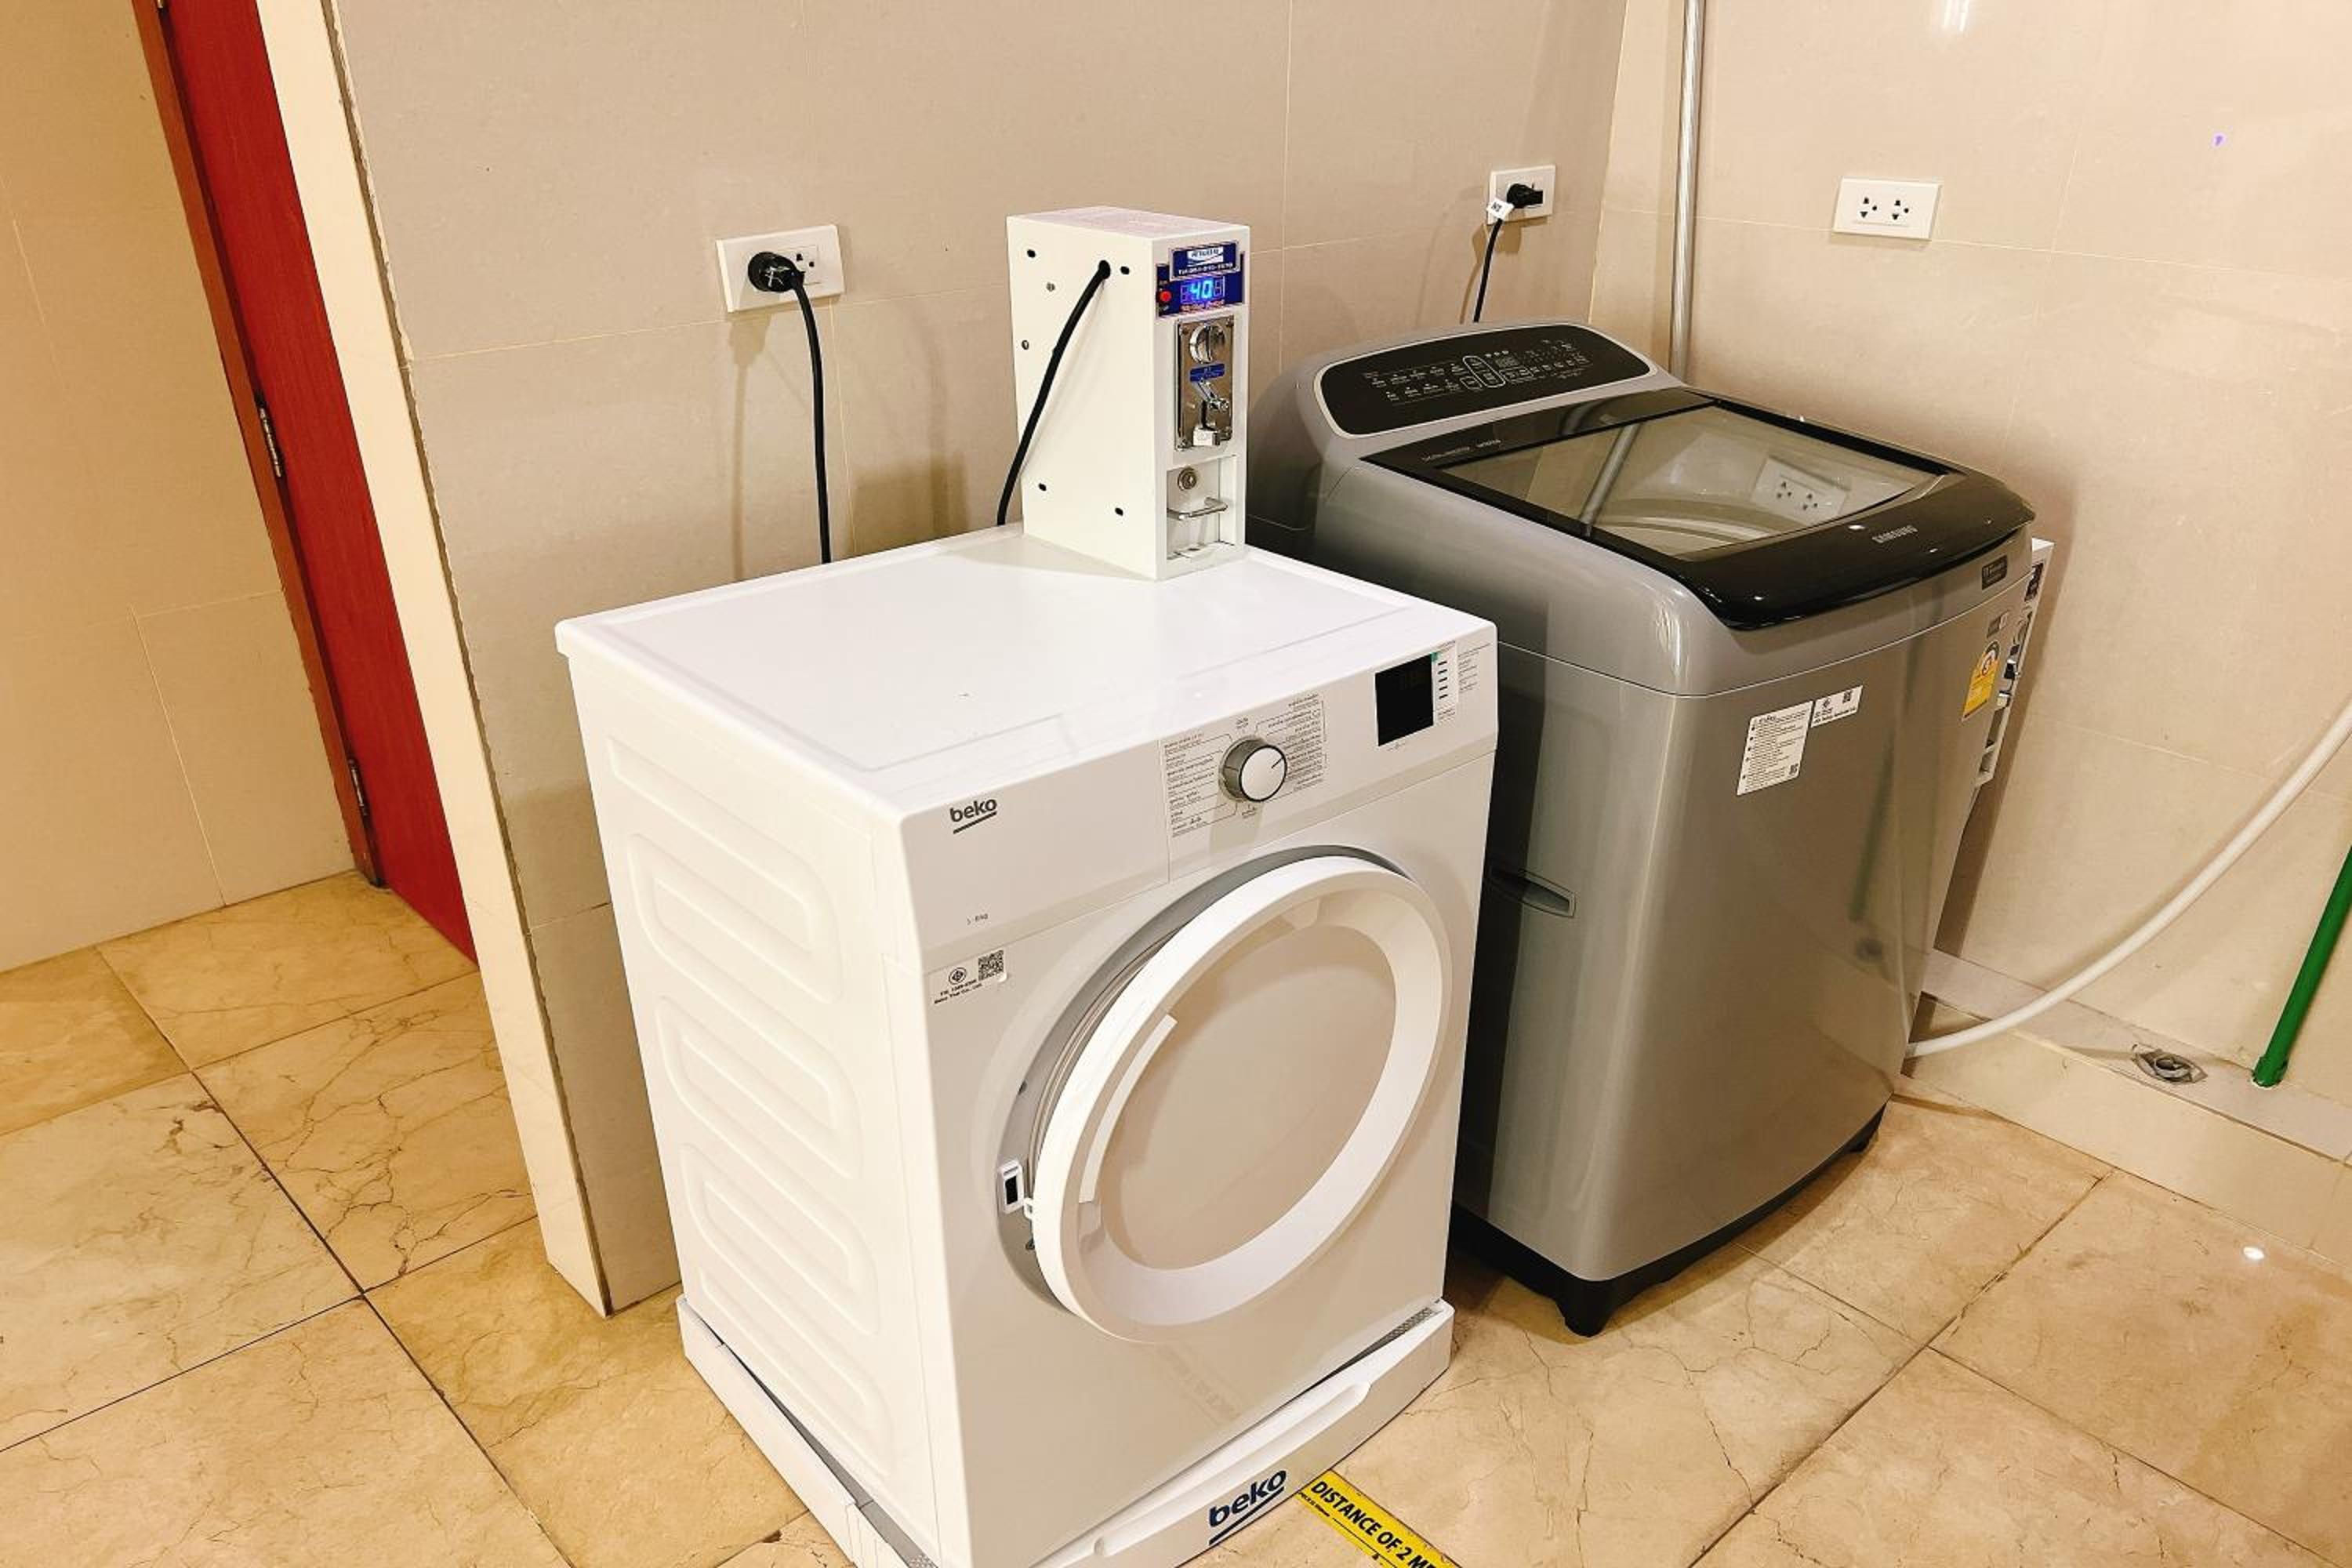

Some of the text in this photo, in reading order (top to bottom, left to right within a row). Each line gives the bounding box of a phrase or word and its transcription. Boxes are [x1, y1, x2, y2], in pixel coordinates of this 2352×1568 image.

[1191, 279, 1214, 299] 40
[949, 798, 998, 822] beko
[1209, 1470, 1287, 1528] beko
[1311, 1481, 1382, 1536] DISTANCE
[1377, 1531, 1402, 1550] OF
[1396, 1547, 1413, 1560] 2
